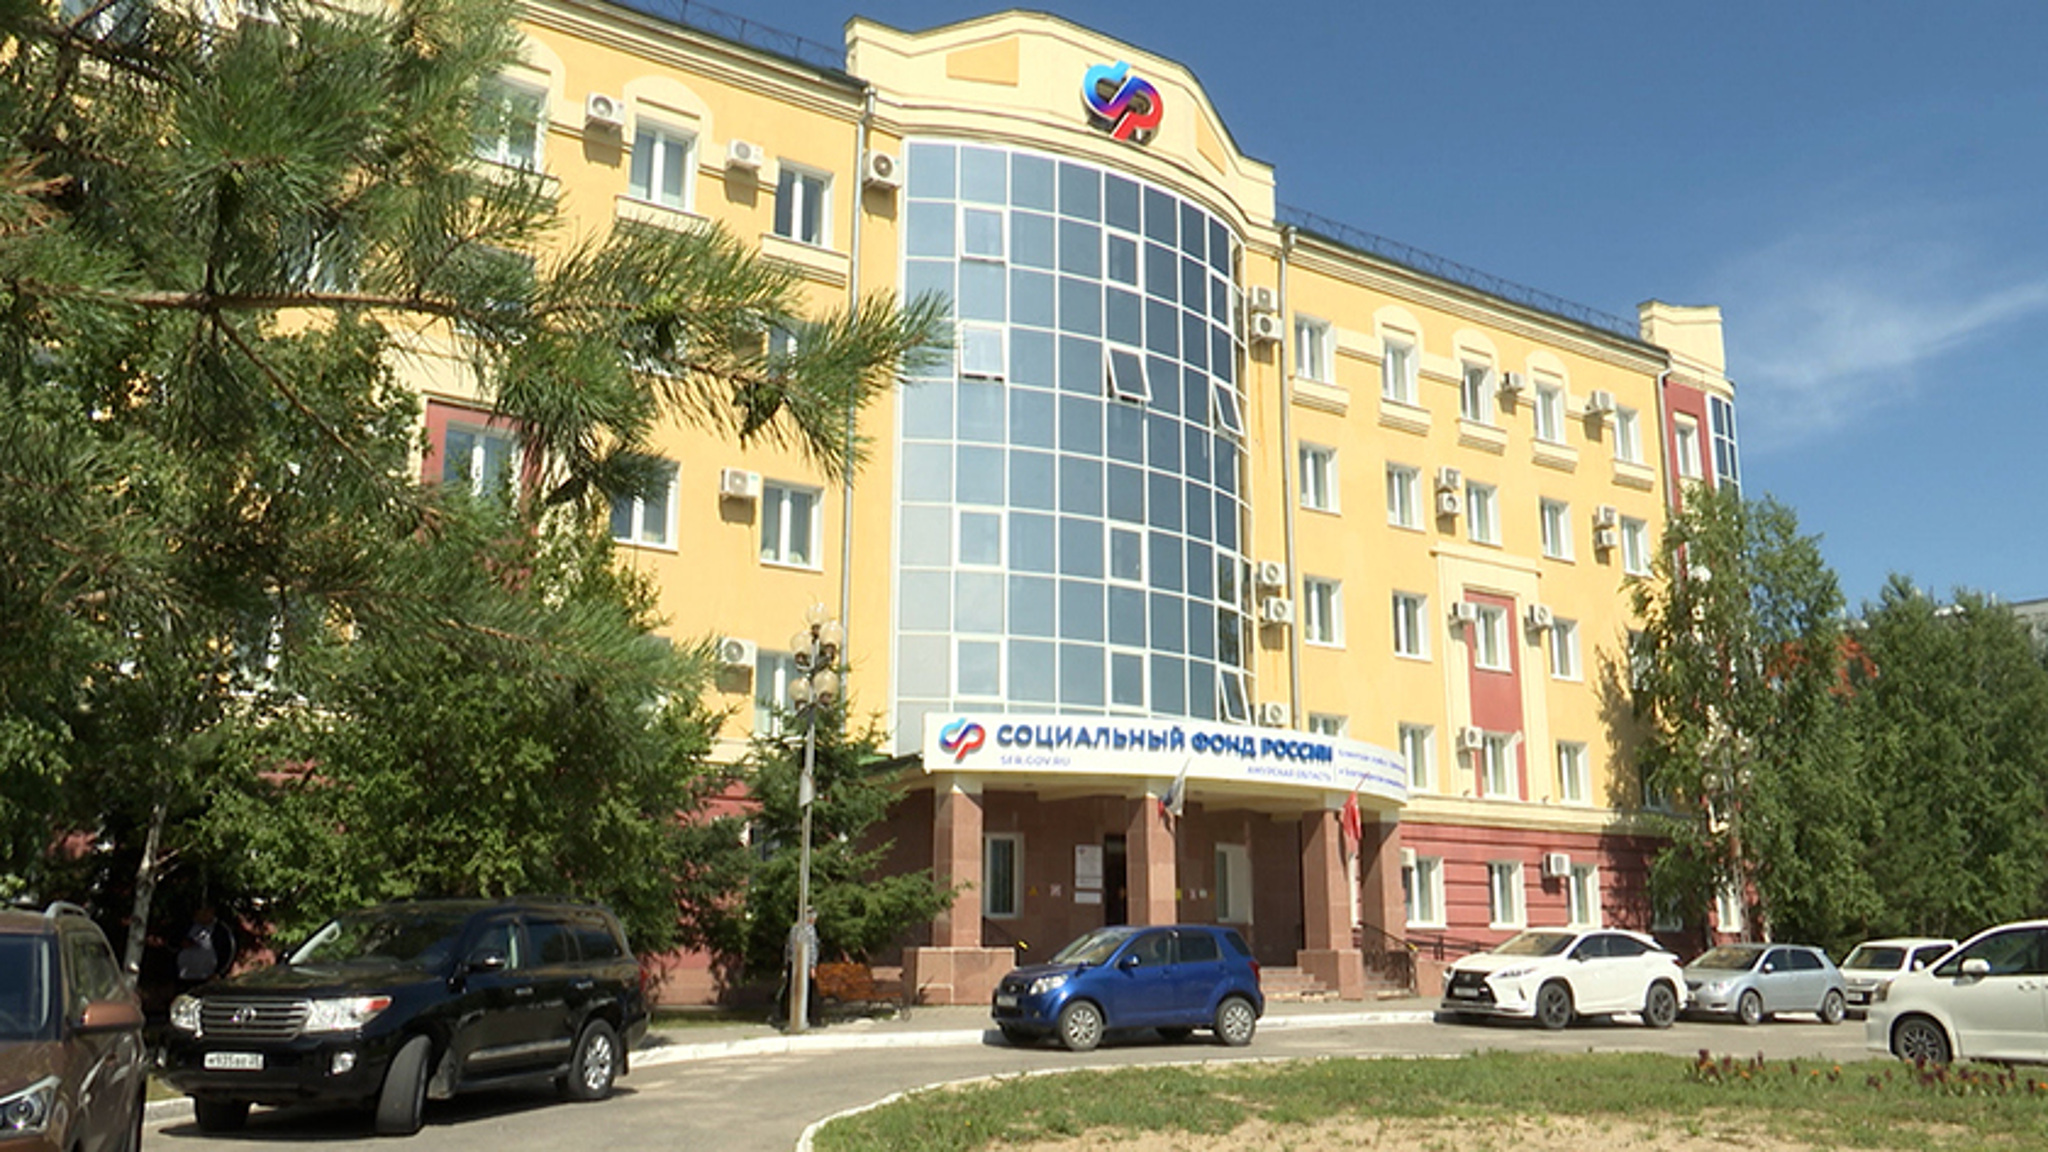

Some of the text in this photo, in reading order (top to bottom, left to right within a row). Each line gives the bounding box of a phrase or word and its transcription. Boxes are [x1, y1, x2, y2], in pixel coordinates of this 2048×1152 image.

[996, 724, 1185, 751] СОЦИАЛЬНЫЙ
[1191, 732, 1256, 759] ФОНД
[1261, 738, 1332, 764] РОССИИ
[1001, 755, 1071, 766] SFR.GOV.RU
